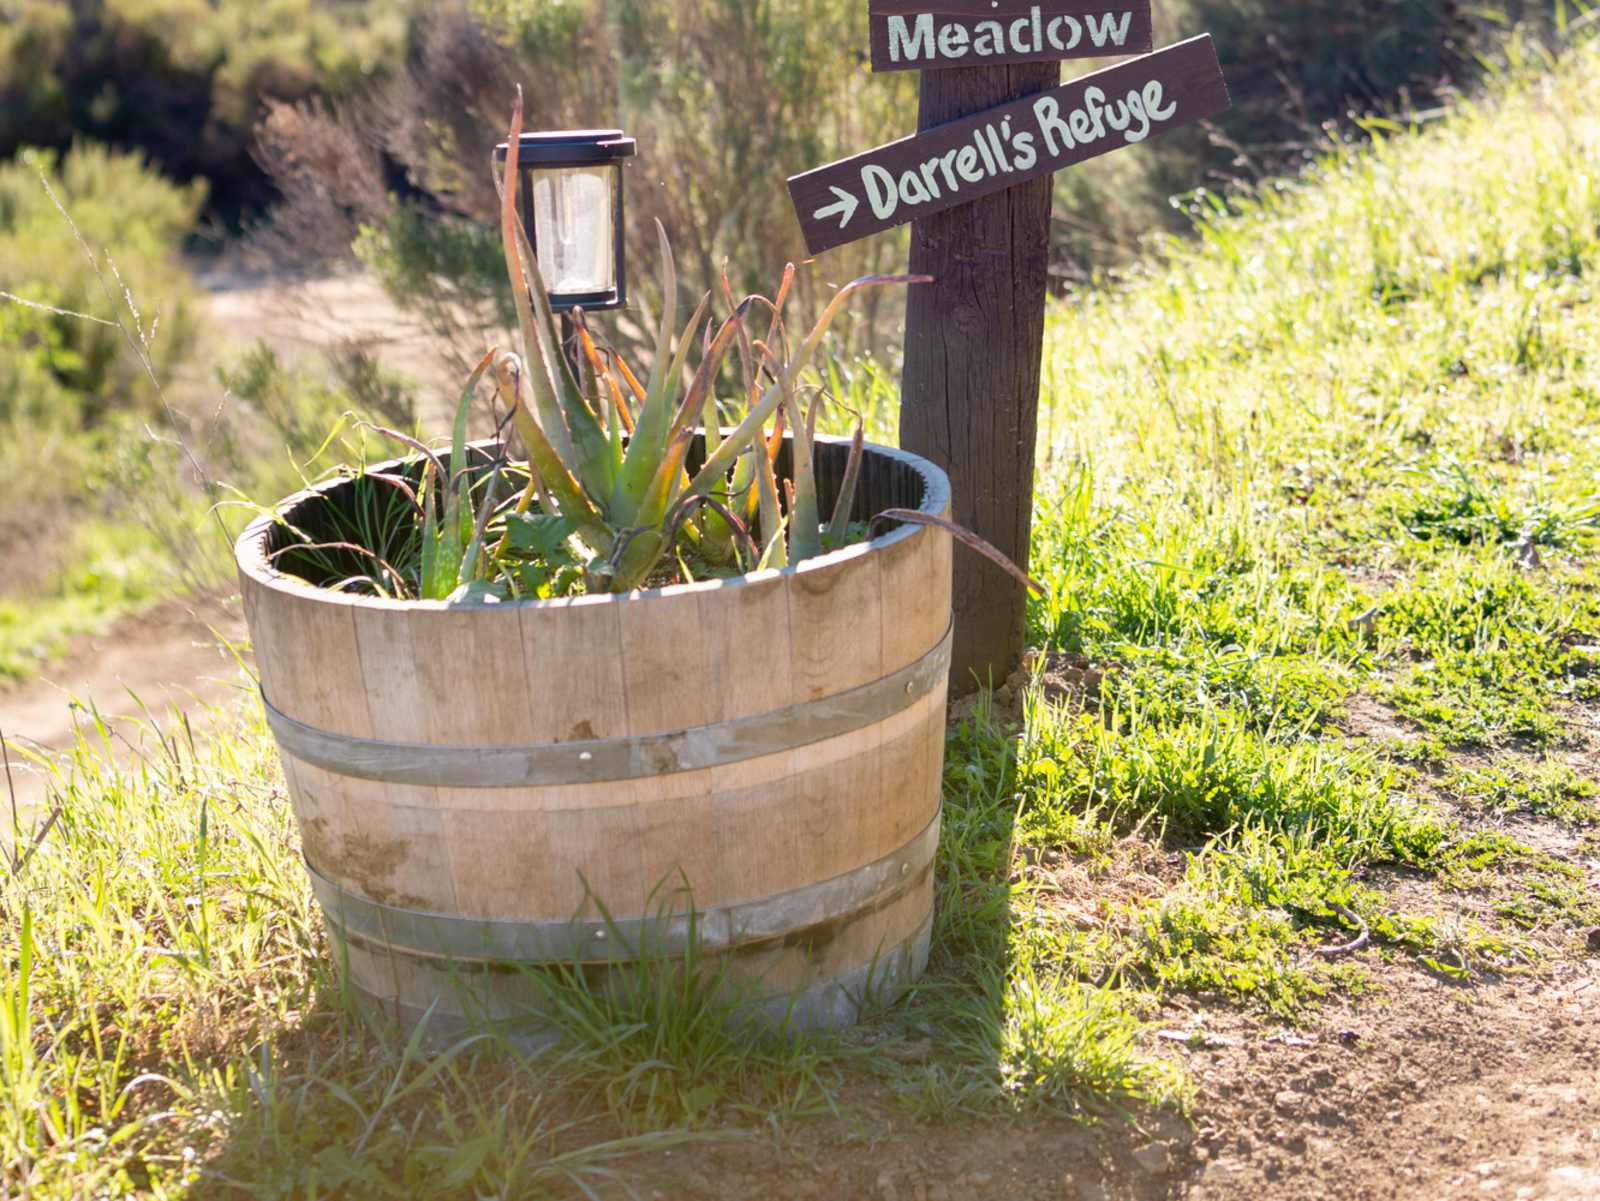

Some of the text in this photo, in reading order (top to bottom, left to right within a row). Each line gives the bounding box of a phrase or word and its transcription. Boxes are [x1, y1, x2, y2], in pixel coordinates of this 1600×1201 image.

[886, 5, 1133, 62] Meadow
[860, 79, 1178, 221] Darrell's Refuge
